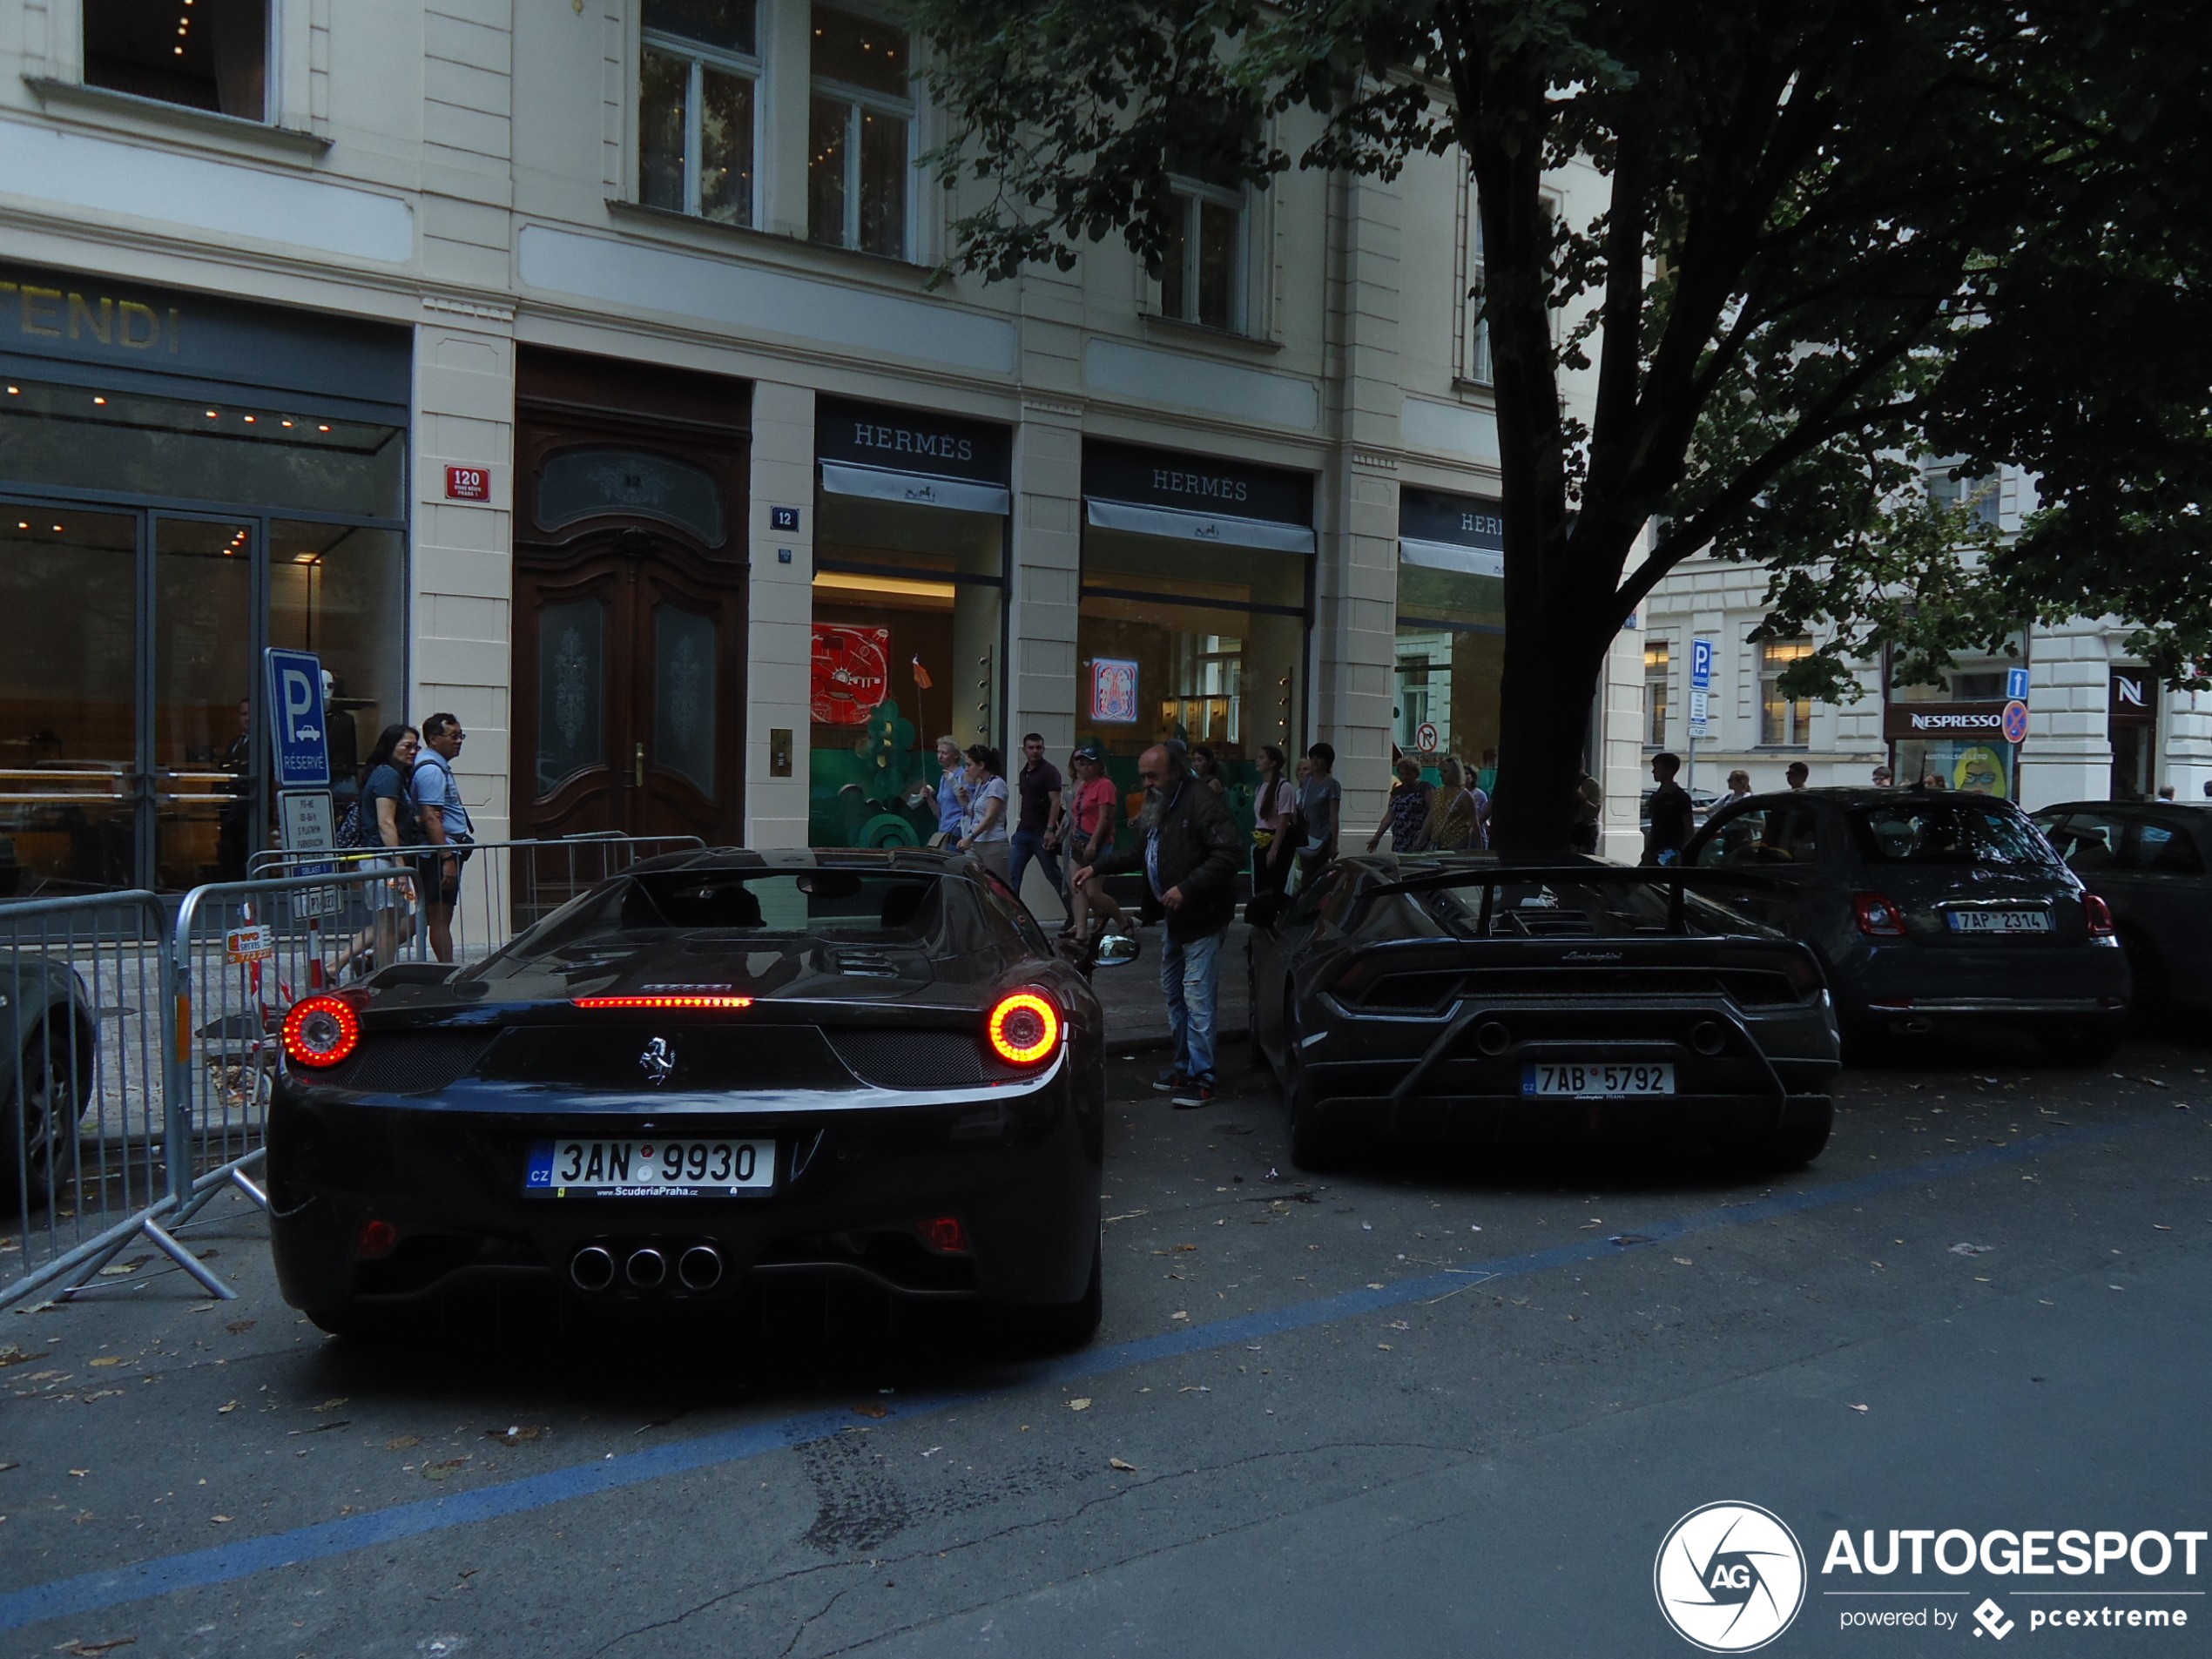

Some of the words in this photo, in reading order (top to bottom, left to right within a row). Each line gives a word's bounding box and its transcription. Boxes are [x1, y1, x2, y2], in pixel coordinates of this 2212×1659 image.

[455, 470, 480, 486] 120
[779, 512, 792, 526] 12
[1461, 513, 1503, 536] HER
[1696, 645, 1709, 673] P
[2111, 675, 2150, 706] N
[282, 668, 313, 744] P
[1909, 713, 2001, 730] NESPRESSO
[283, 752, 325, 770] RÉSERVÉ
[301, 865, 321, 875] OBLAST
[1959, 913, 1989, 928] 7AP
[2001, 913, 2040, 928] 2314
[240, 932, 260, 941] WC
[240, 941, 260, 951] servis
[1541, 1067, 1586, 1092] 7AB
[1604, 1067, 1664, 1091] 5792
[530, 1170, 549, 1182] CZ
[561, 1143, 631, 1182] 3AN
[662, 1143, 756, 1181] 9930
[597, 1186, 699, 1197] www.ScuderiaPraha.cz
